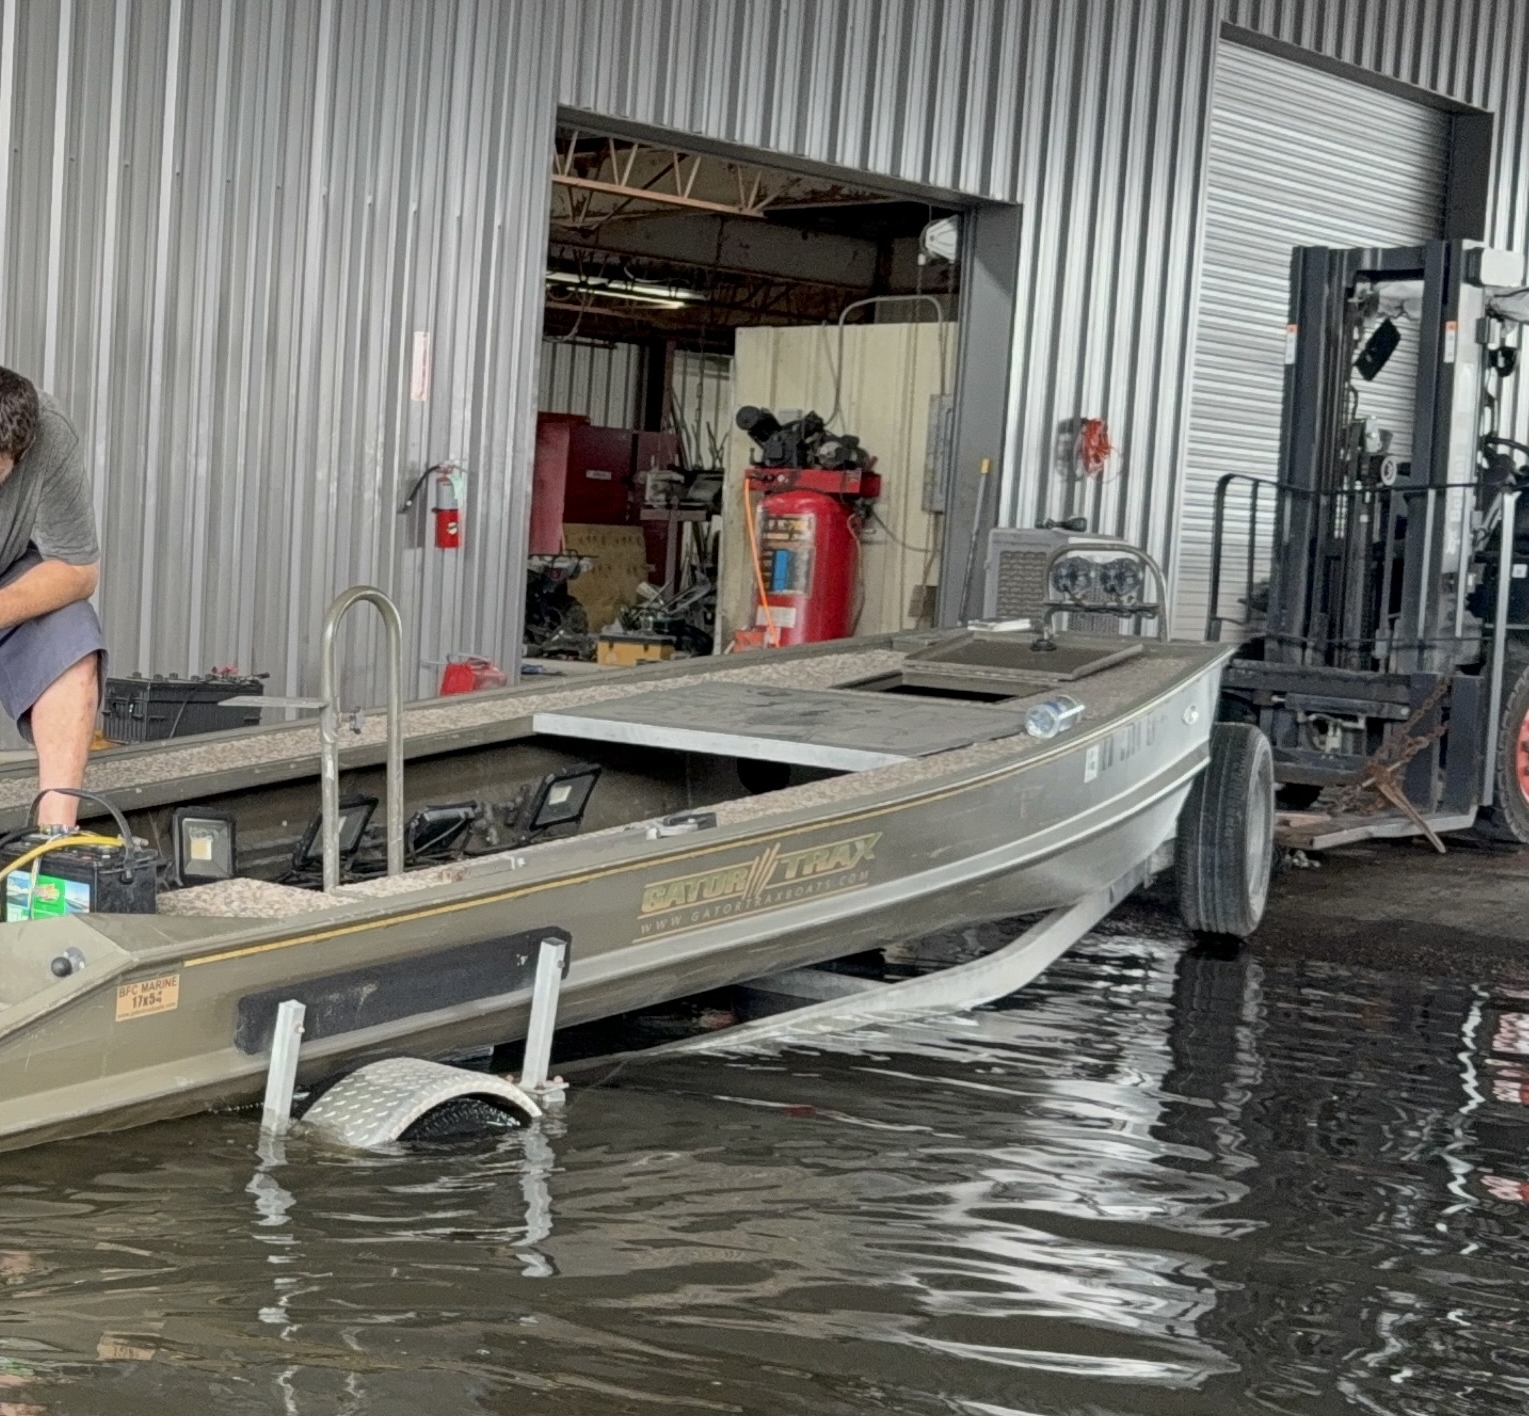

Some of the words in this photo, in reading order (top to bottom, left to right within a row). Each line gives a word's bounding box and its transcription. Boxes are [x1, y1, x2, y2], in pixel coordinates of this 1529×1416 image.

[641, 868, 749, 913] GATOR
[780, 832, 883, 880] TRAX
[118, 984, 139, 999] BFC
[141, 976, 178, 994] MARINE
